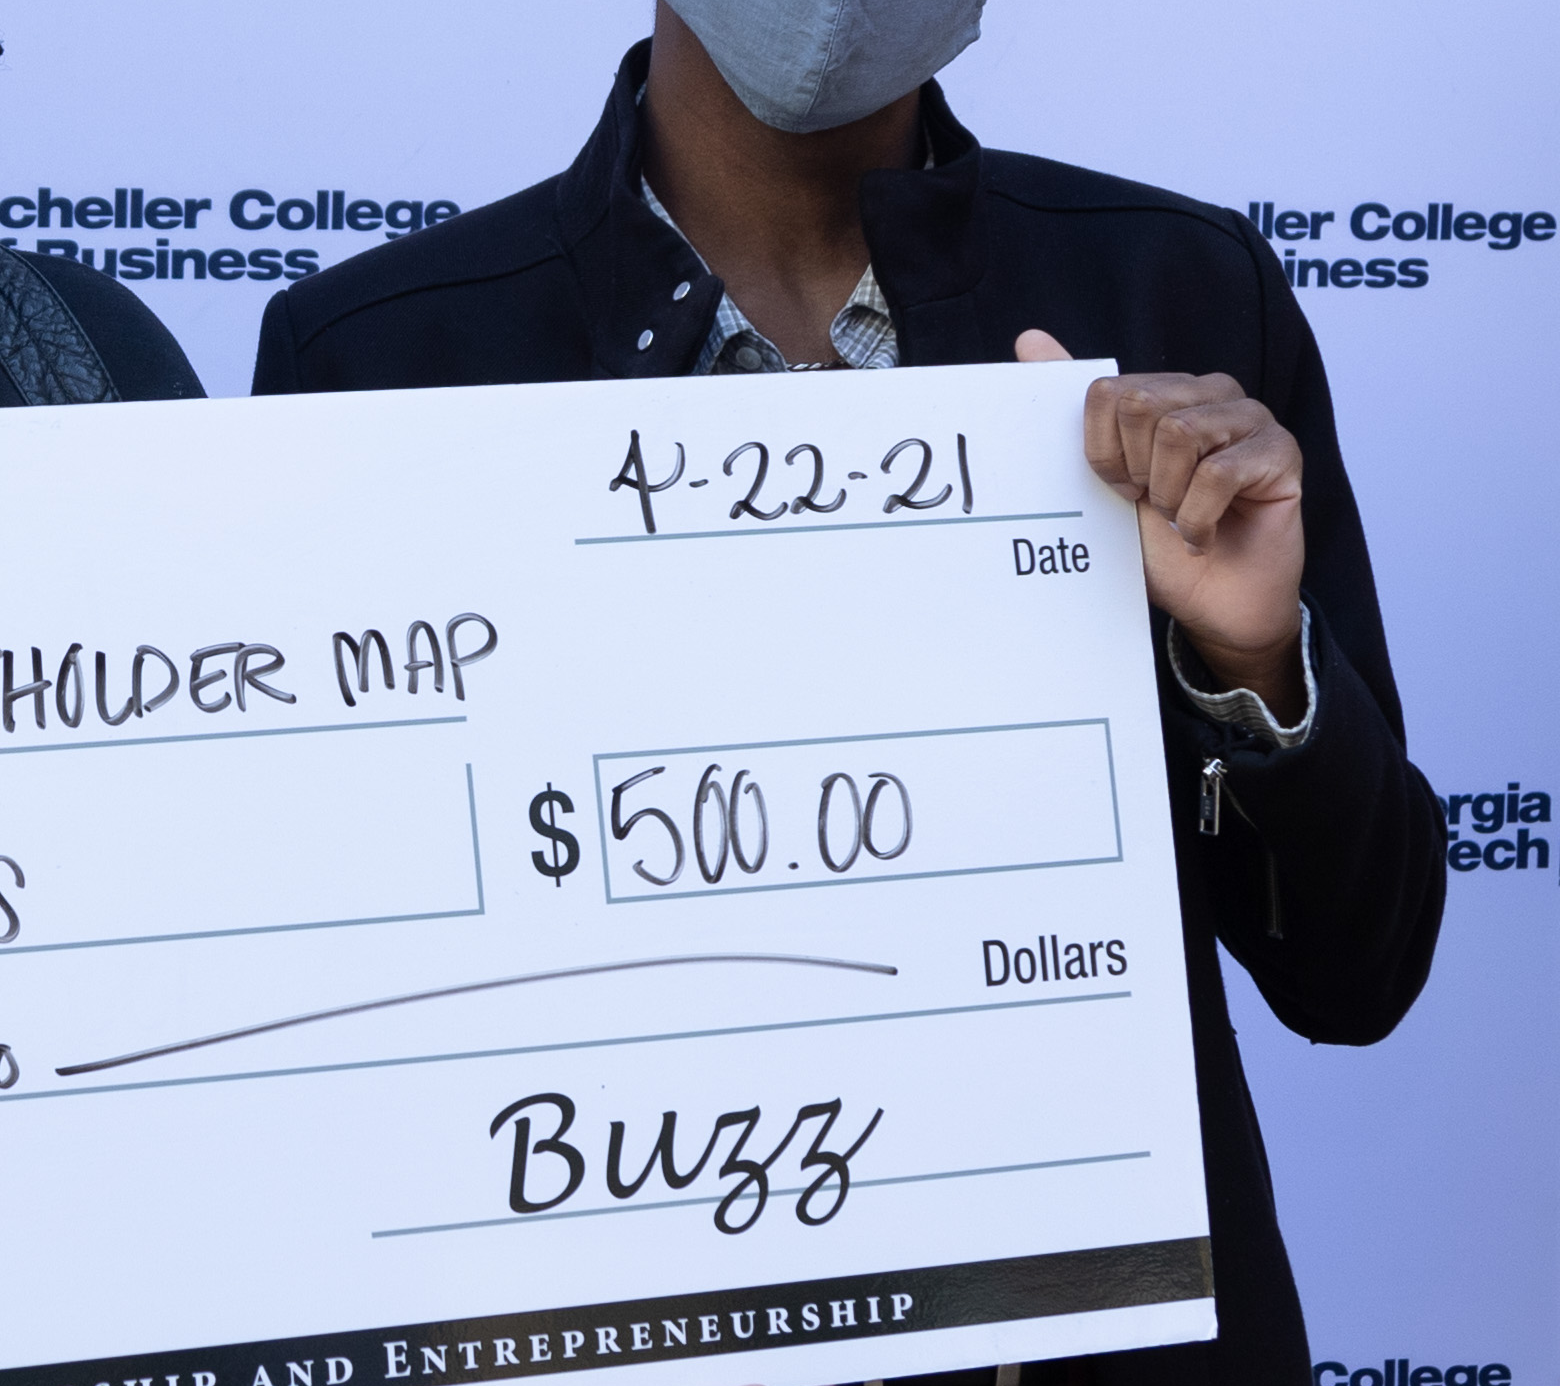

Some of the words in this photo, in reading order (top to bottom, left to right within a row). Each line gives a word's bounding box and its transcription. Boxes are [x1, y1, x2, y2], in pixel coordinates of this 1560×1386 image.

[1351, 203, 1556, 250] College
[608, 428, 978, 535] 4-22-21
[1013, 538, 1089, 575] Date
[332, 613, 498, 707] MAP
[529, 783, 579, 887] $
[611, 764, 910, 885] 500.00
[1436, 781, 1551, 834] rgia
[1447, 827, 1550, 872] ech
[983, 935, 1126, 986] Dollars
[489, 1089, 885, 1235] Buzz
[383, 1293, 916, 1379] ENTREPRENEURSHIP
